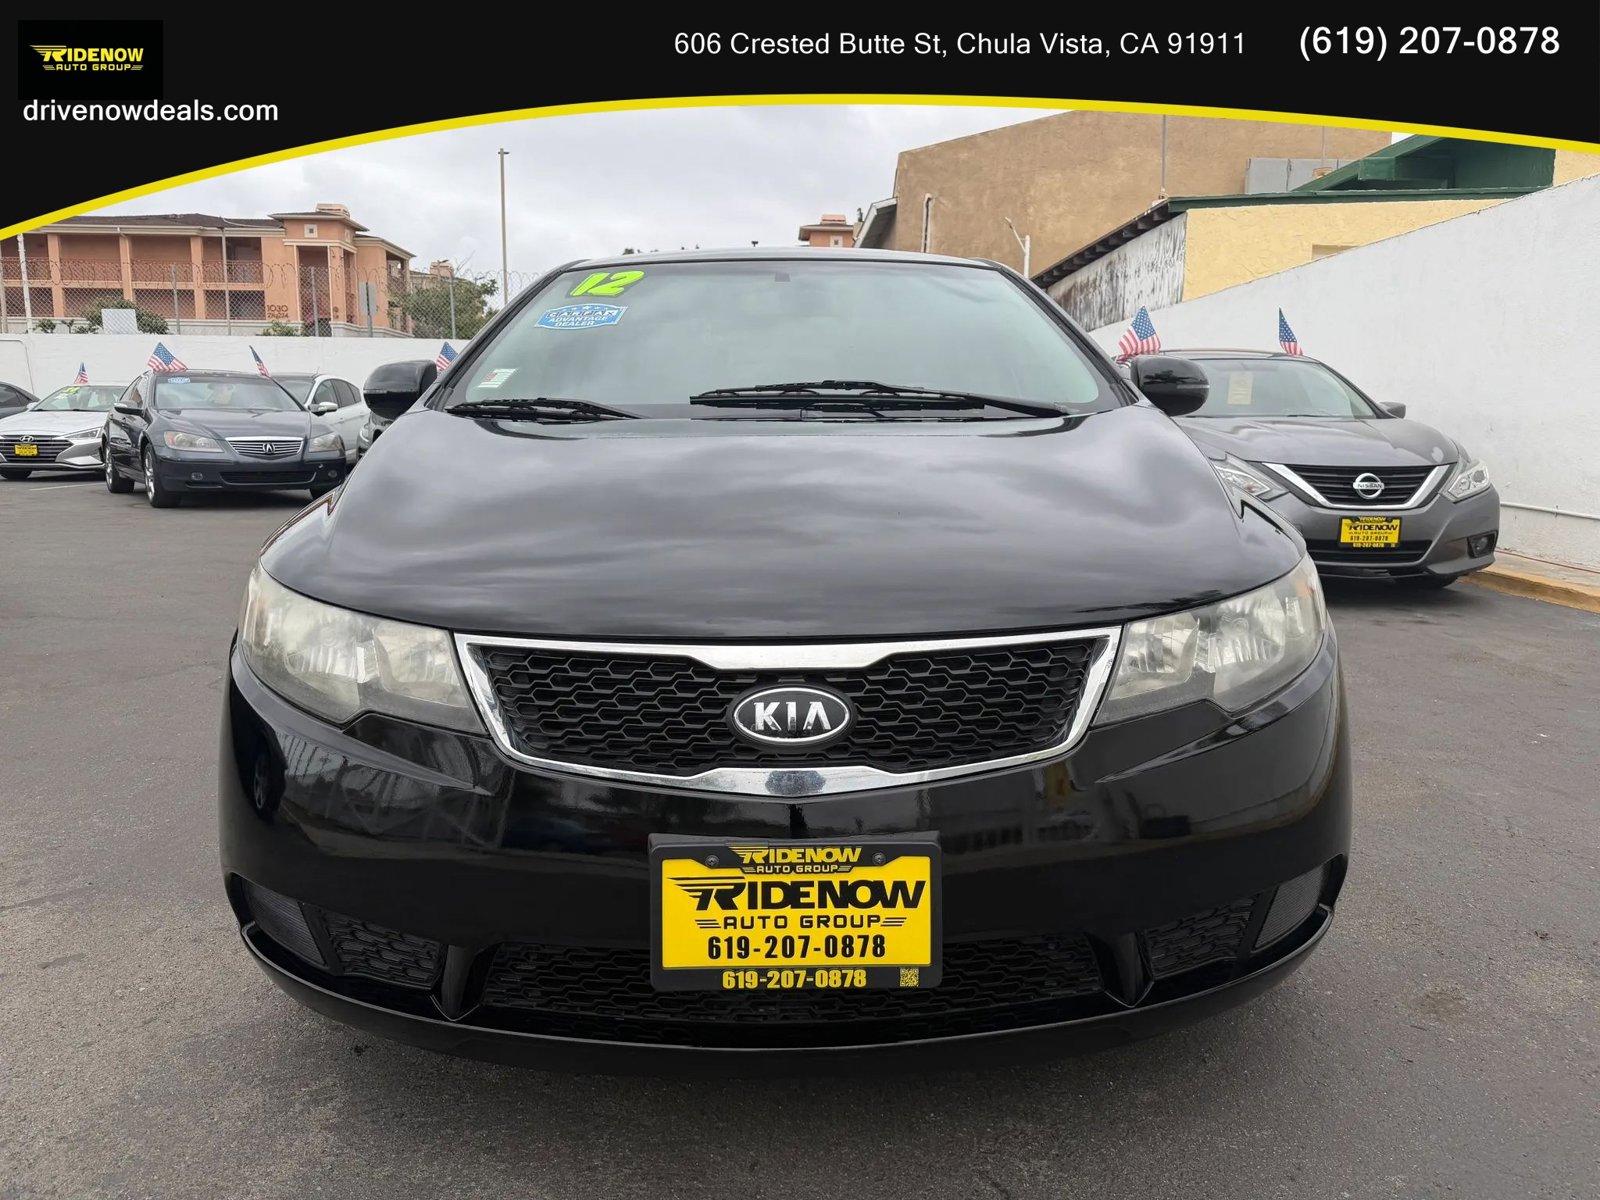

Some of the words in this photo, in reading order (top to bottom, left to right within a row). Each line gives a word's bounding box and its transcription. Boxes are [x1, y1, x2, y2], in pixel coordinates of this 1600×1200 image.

[569, 270, 645, 296] 12
[266, 304, 289, 313] 1030
[753, 701, 832, 731] KIA
[729, 846, 862, 864] RIDENOW
[756, 865, 791, 873] AUTO
[795, 864, 839, 873] GROUP
[667, 876, 926, 911] RIDENOW
[723, 915, 788, 930] AUTO
[799, 914, 881, 929] GROUP
[707, 934, 886, 960] 619-207-0878
[722, 969, 867, 989] 619-207-0878
